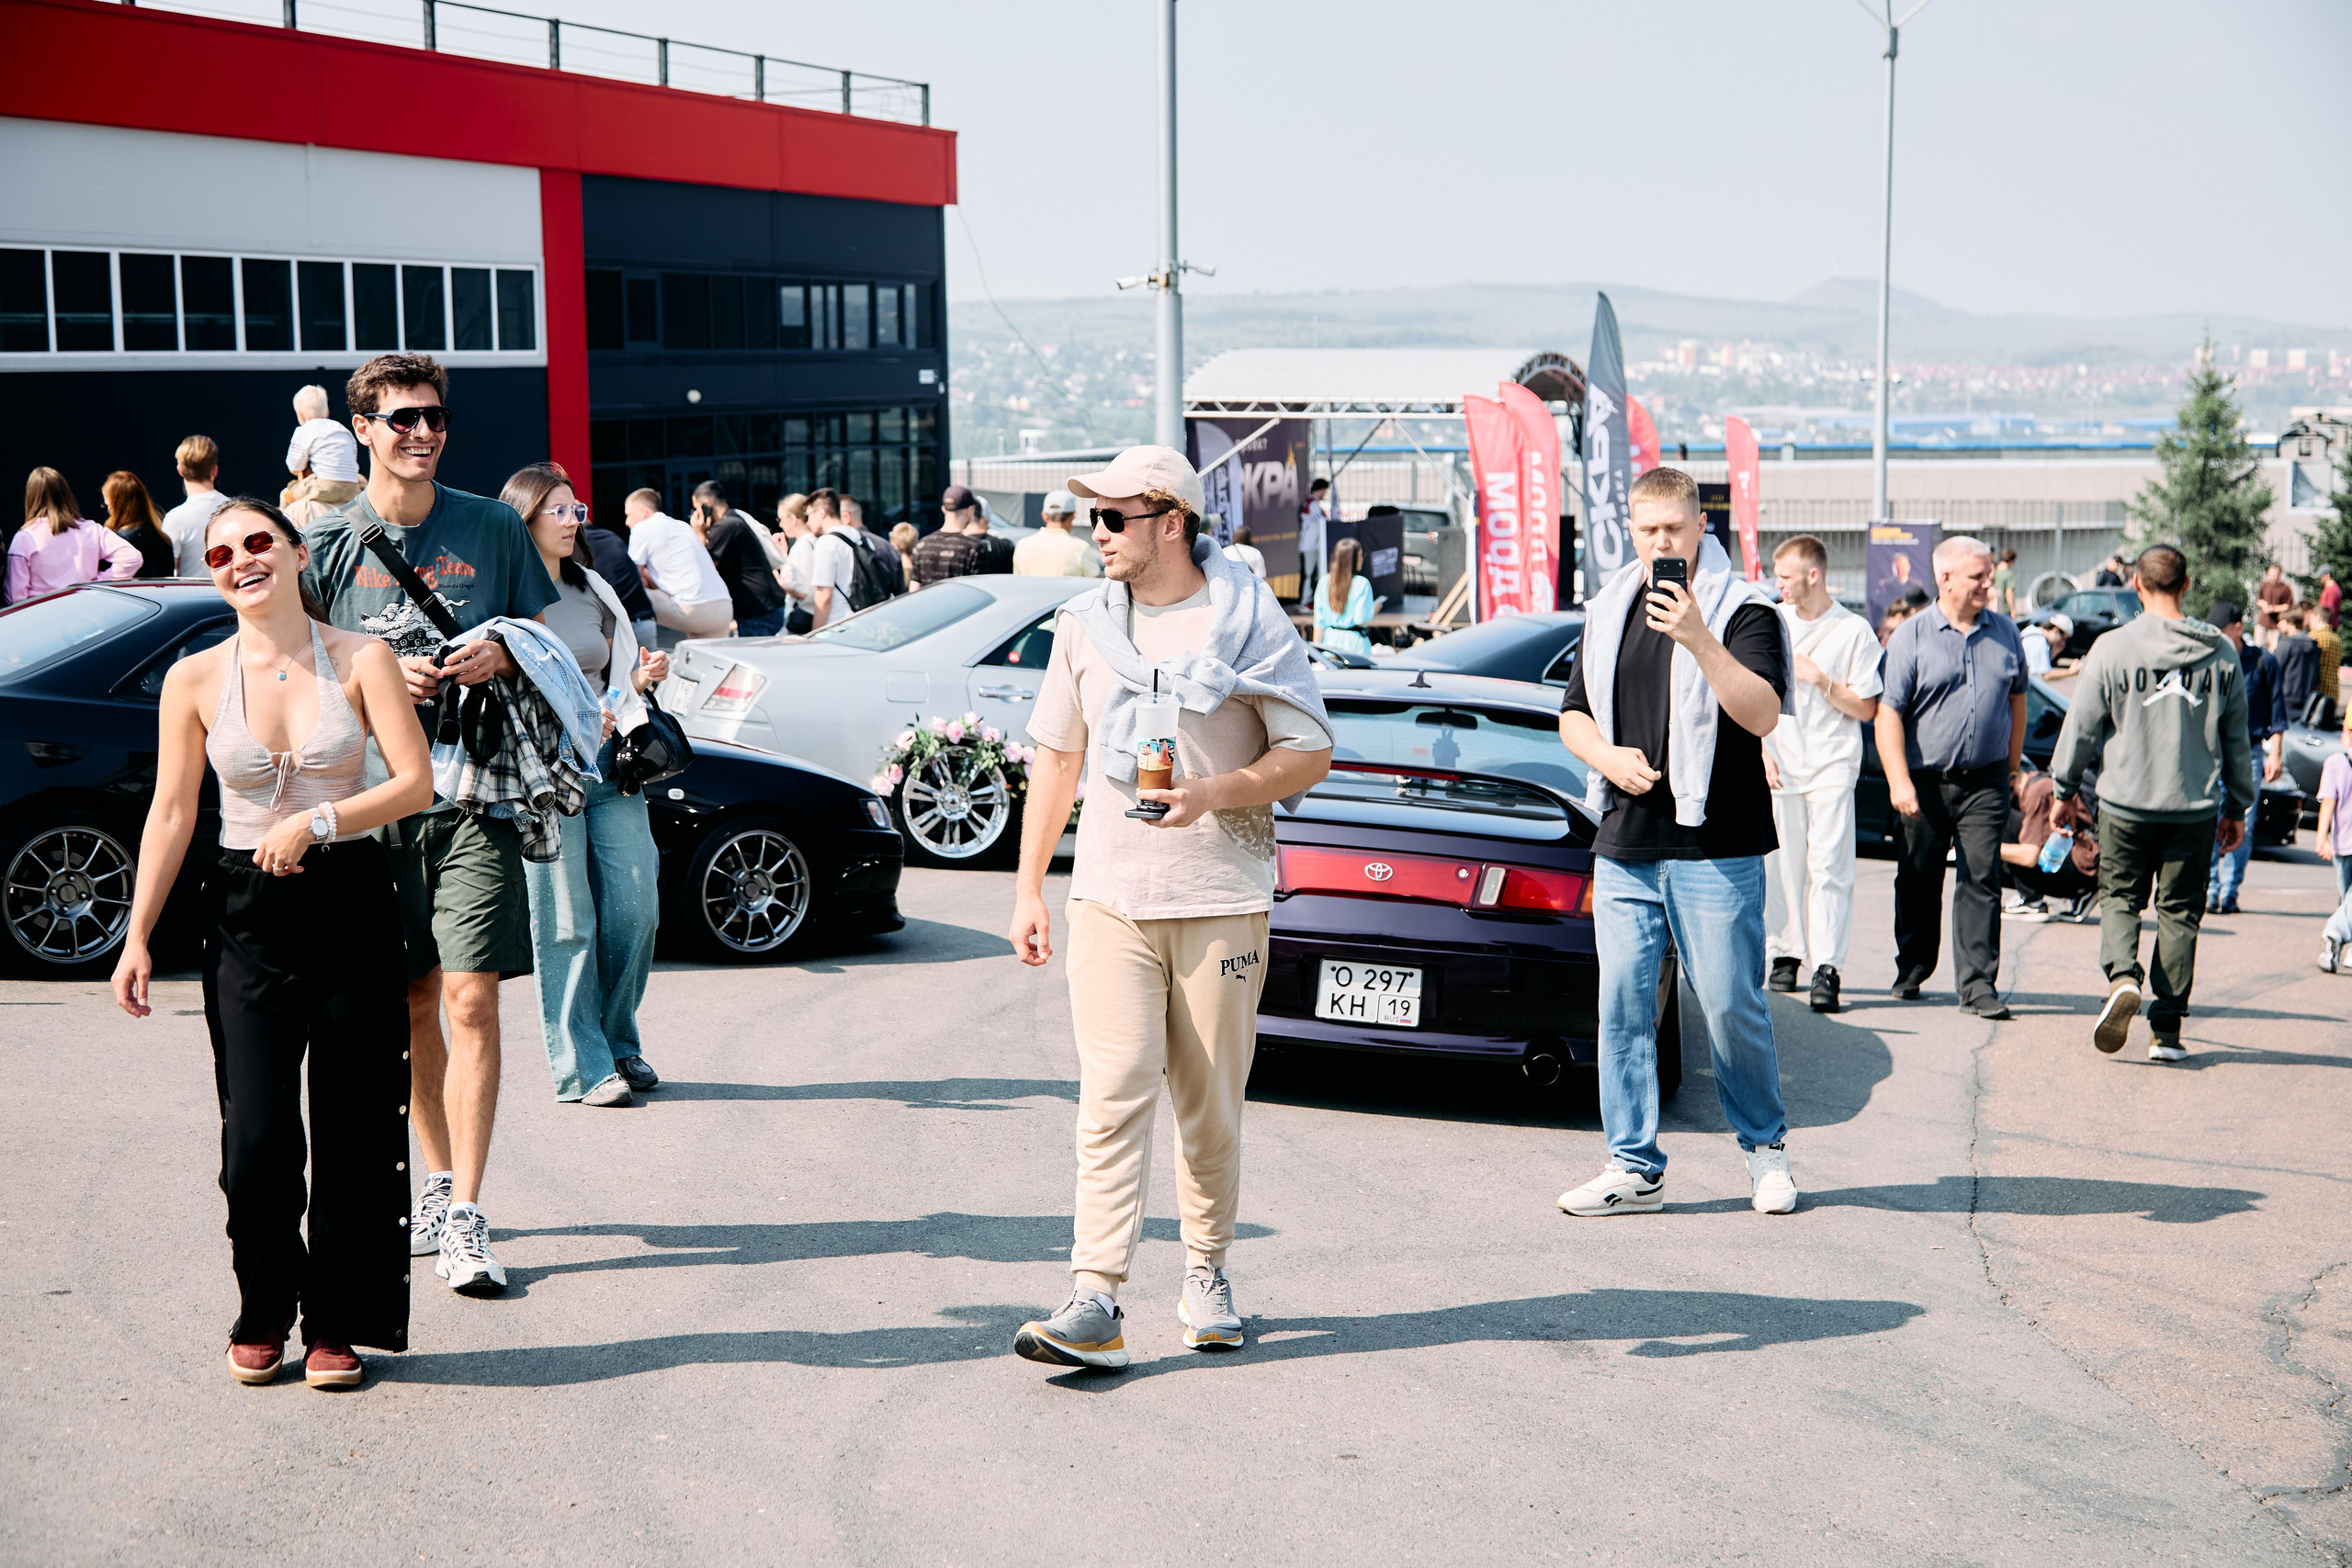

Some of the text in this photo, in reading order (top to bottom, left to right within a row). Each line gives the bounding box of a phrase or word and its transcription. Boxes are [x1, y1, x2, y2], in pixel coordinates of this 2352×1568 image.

[1240, 460, 1299, 510] КРА
[354, 565, 391, 588] Nike
[435, 555, 476, 578] Team
[1220, 949, 1260, 976] PUMA
[1363, 969, 1411, 993] 297
[1388, 998, 1410, 1017] 19
